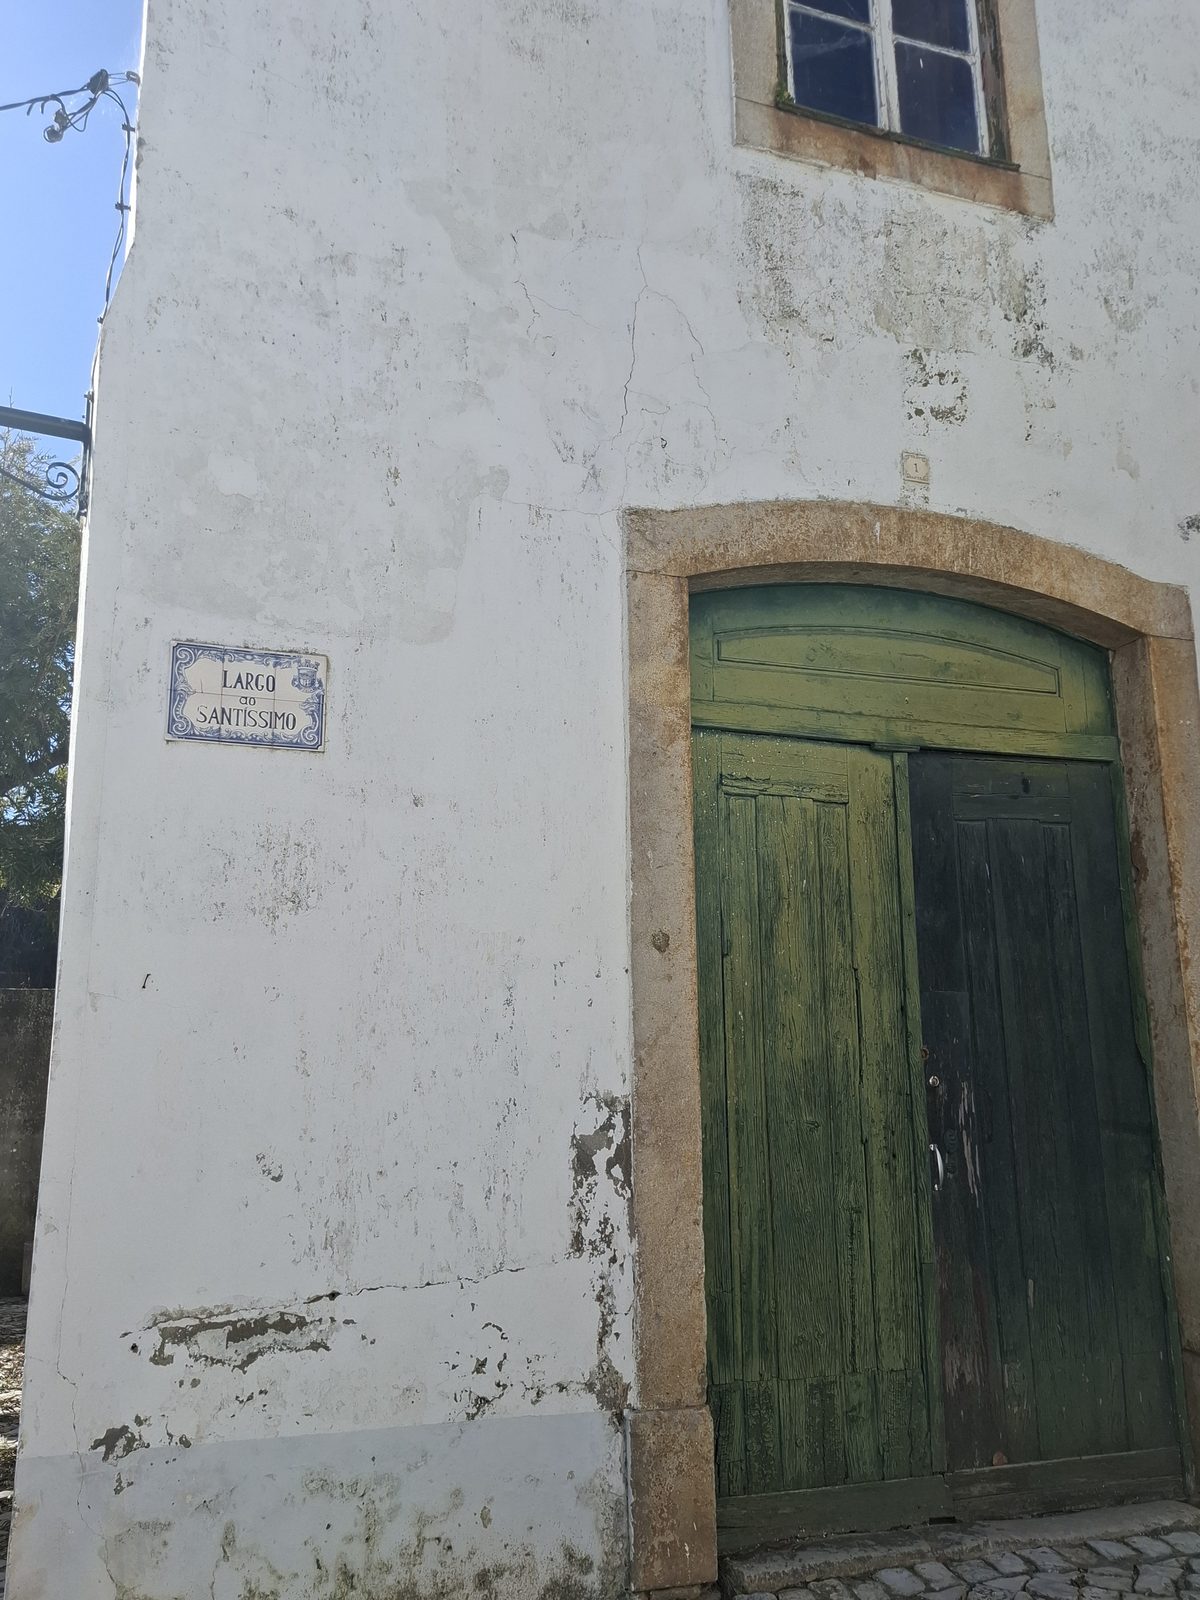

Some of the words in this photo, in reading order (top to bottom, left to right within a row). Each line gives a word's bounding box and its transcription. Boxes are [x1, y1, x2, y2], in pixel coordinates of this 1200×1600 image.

[223, 670, 275, 692] LARGO
[239, 696, 256, 706] ao
[196, 705, 296, 730] SANTÍSSIMO
